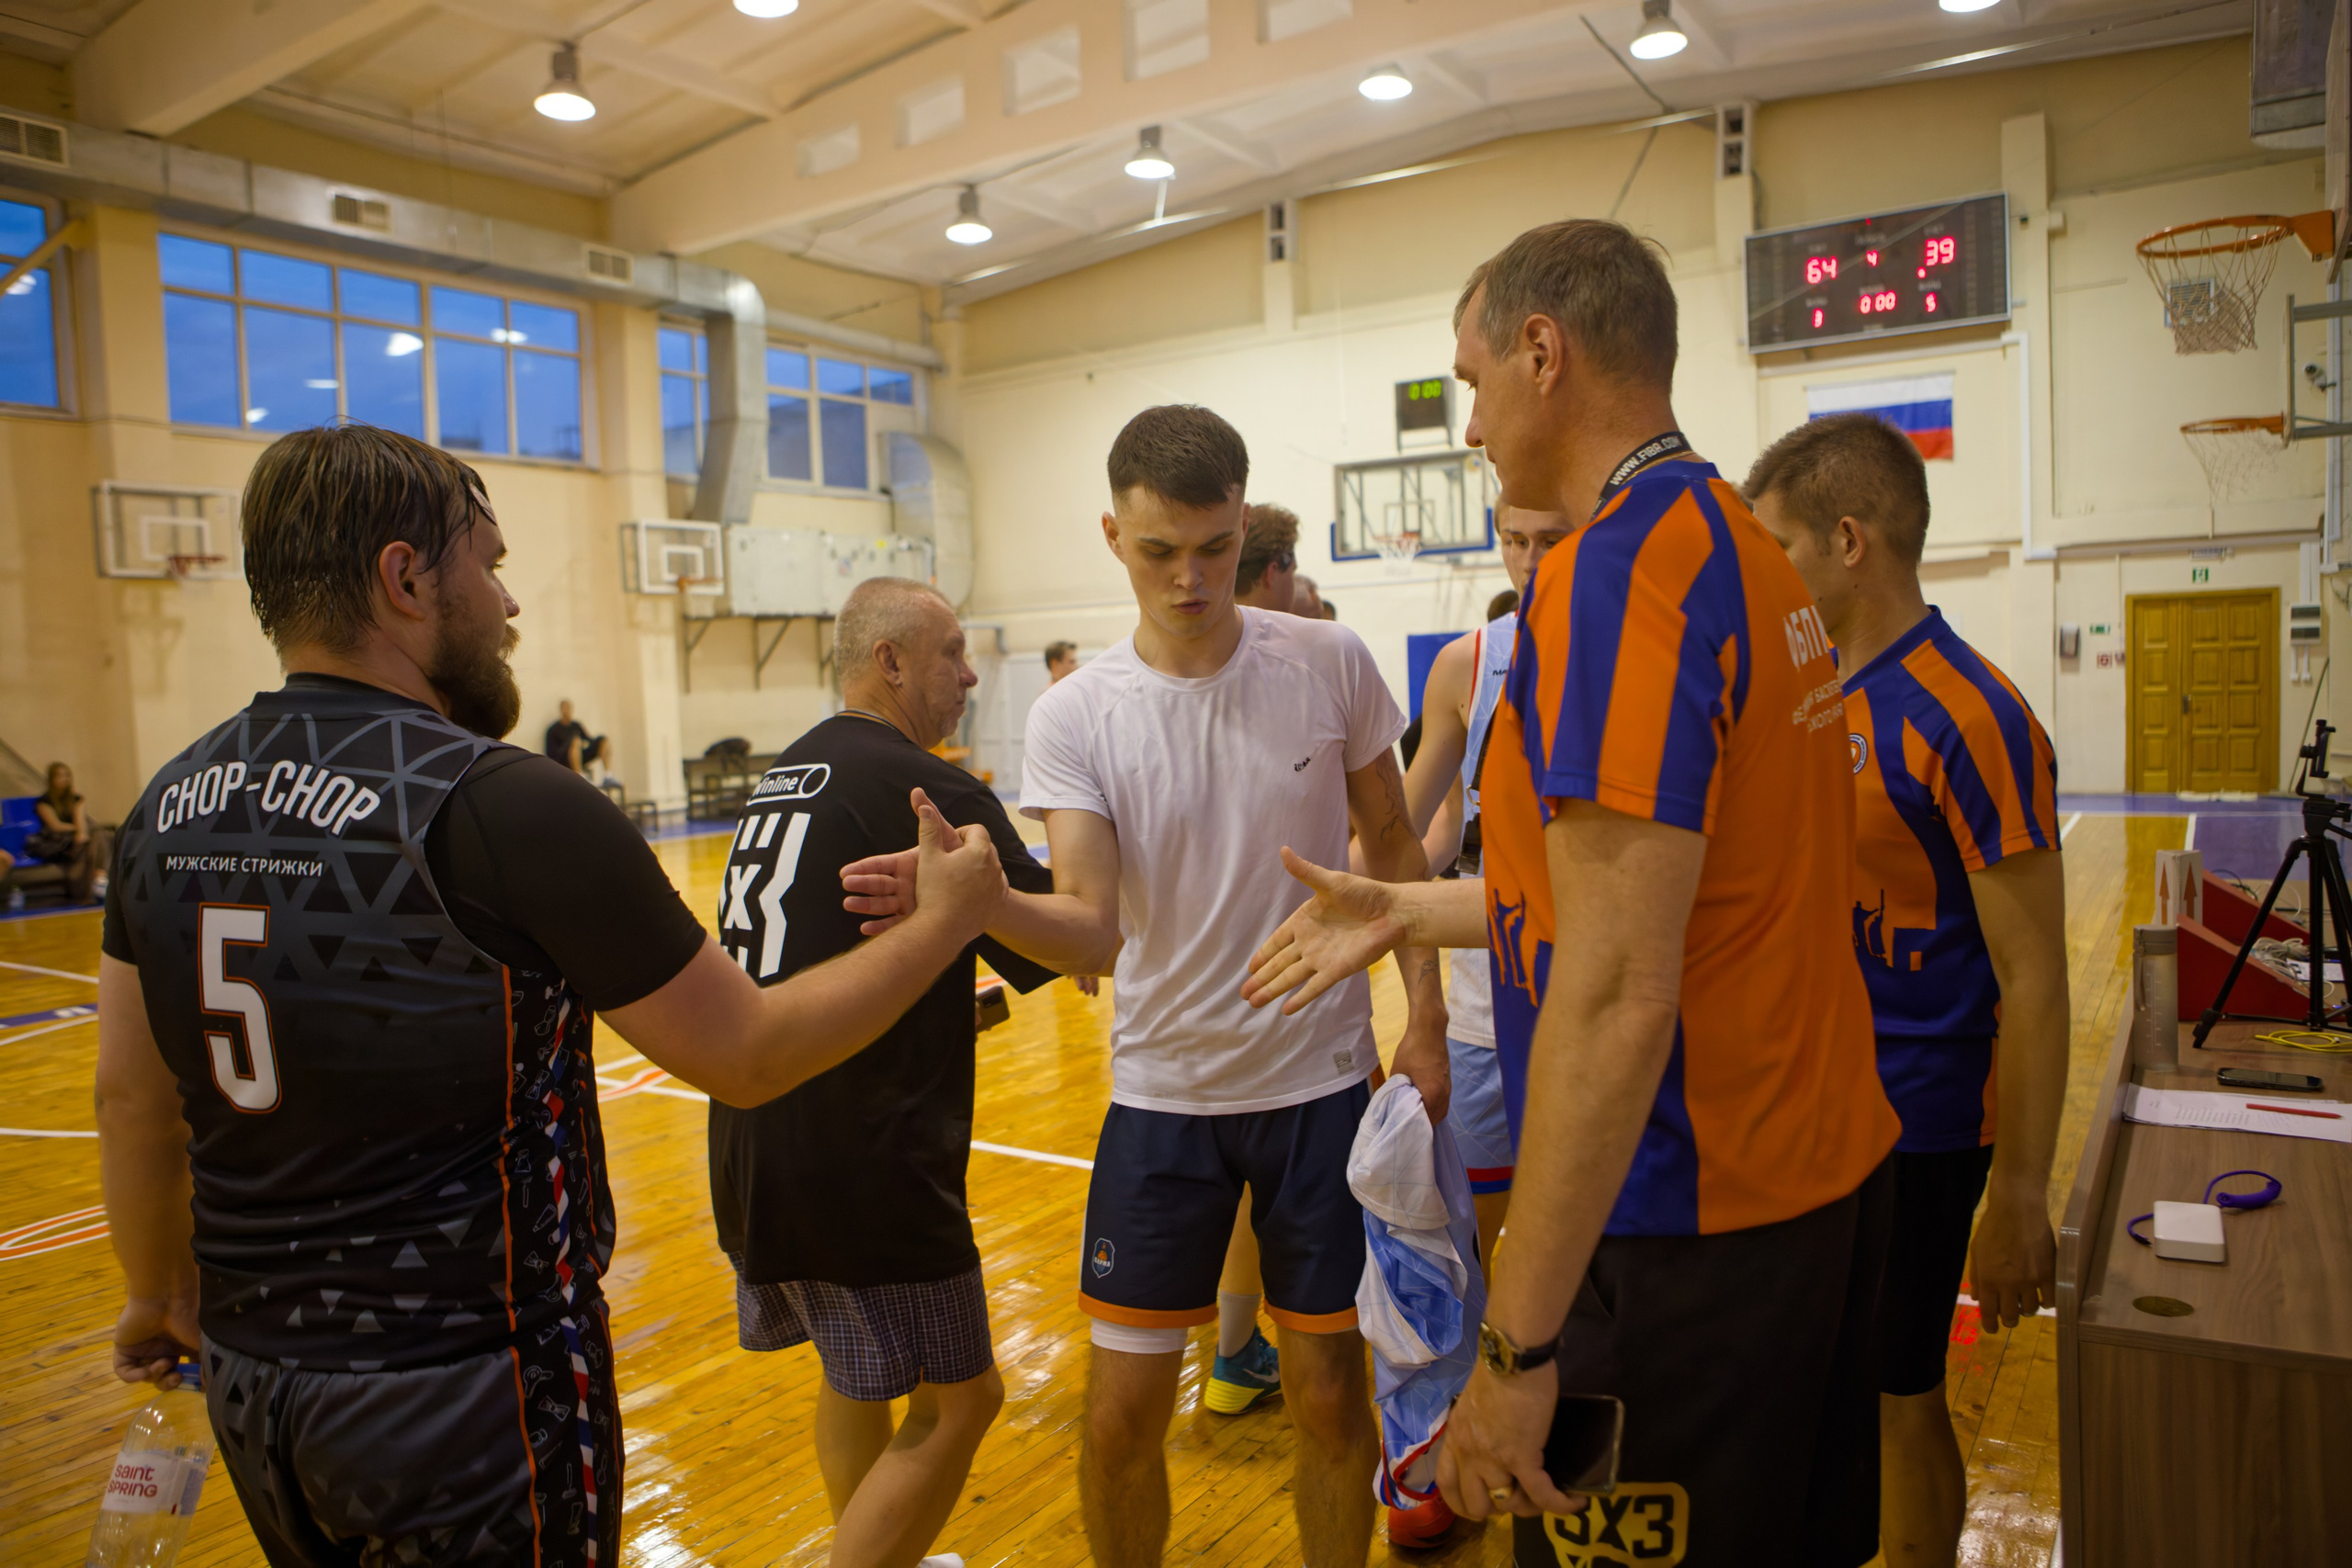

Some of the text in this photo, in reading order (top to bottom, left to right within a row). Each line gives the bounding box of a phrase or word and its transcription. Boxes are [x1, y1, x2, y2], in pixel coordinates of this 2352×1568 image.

[1866, 249, 1878, 266] 4
[1925, 235, 1955, 266] 39
[1805, 255, 1838, 285] 64
[156, 760, 381, 836] CHOP-CHOP
[165, 854, 324, 877] МУЖСКИЕ СТРИЖКИ
[198, 902, 282, 1114] 5
